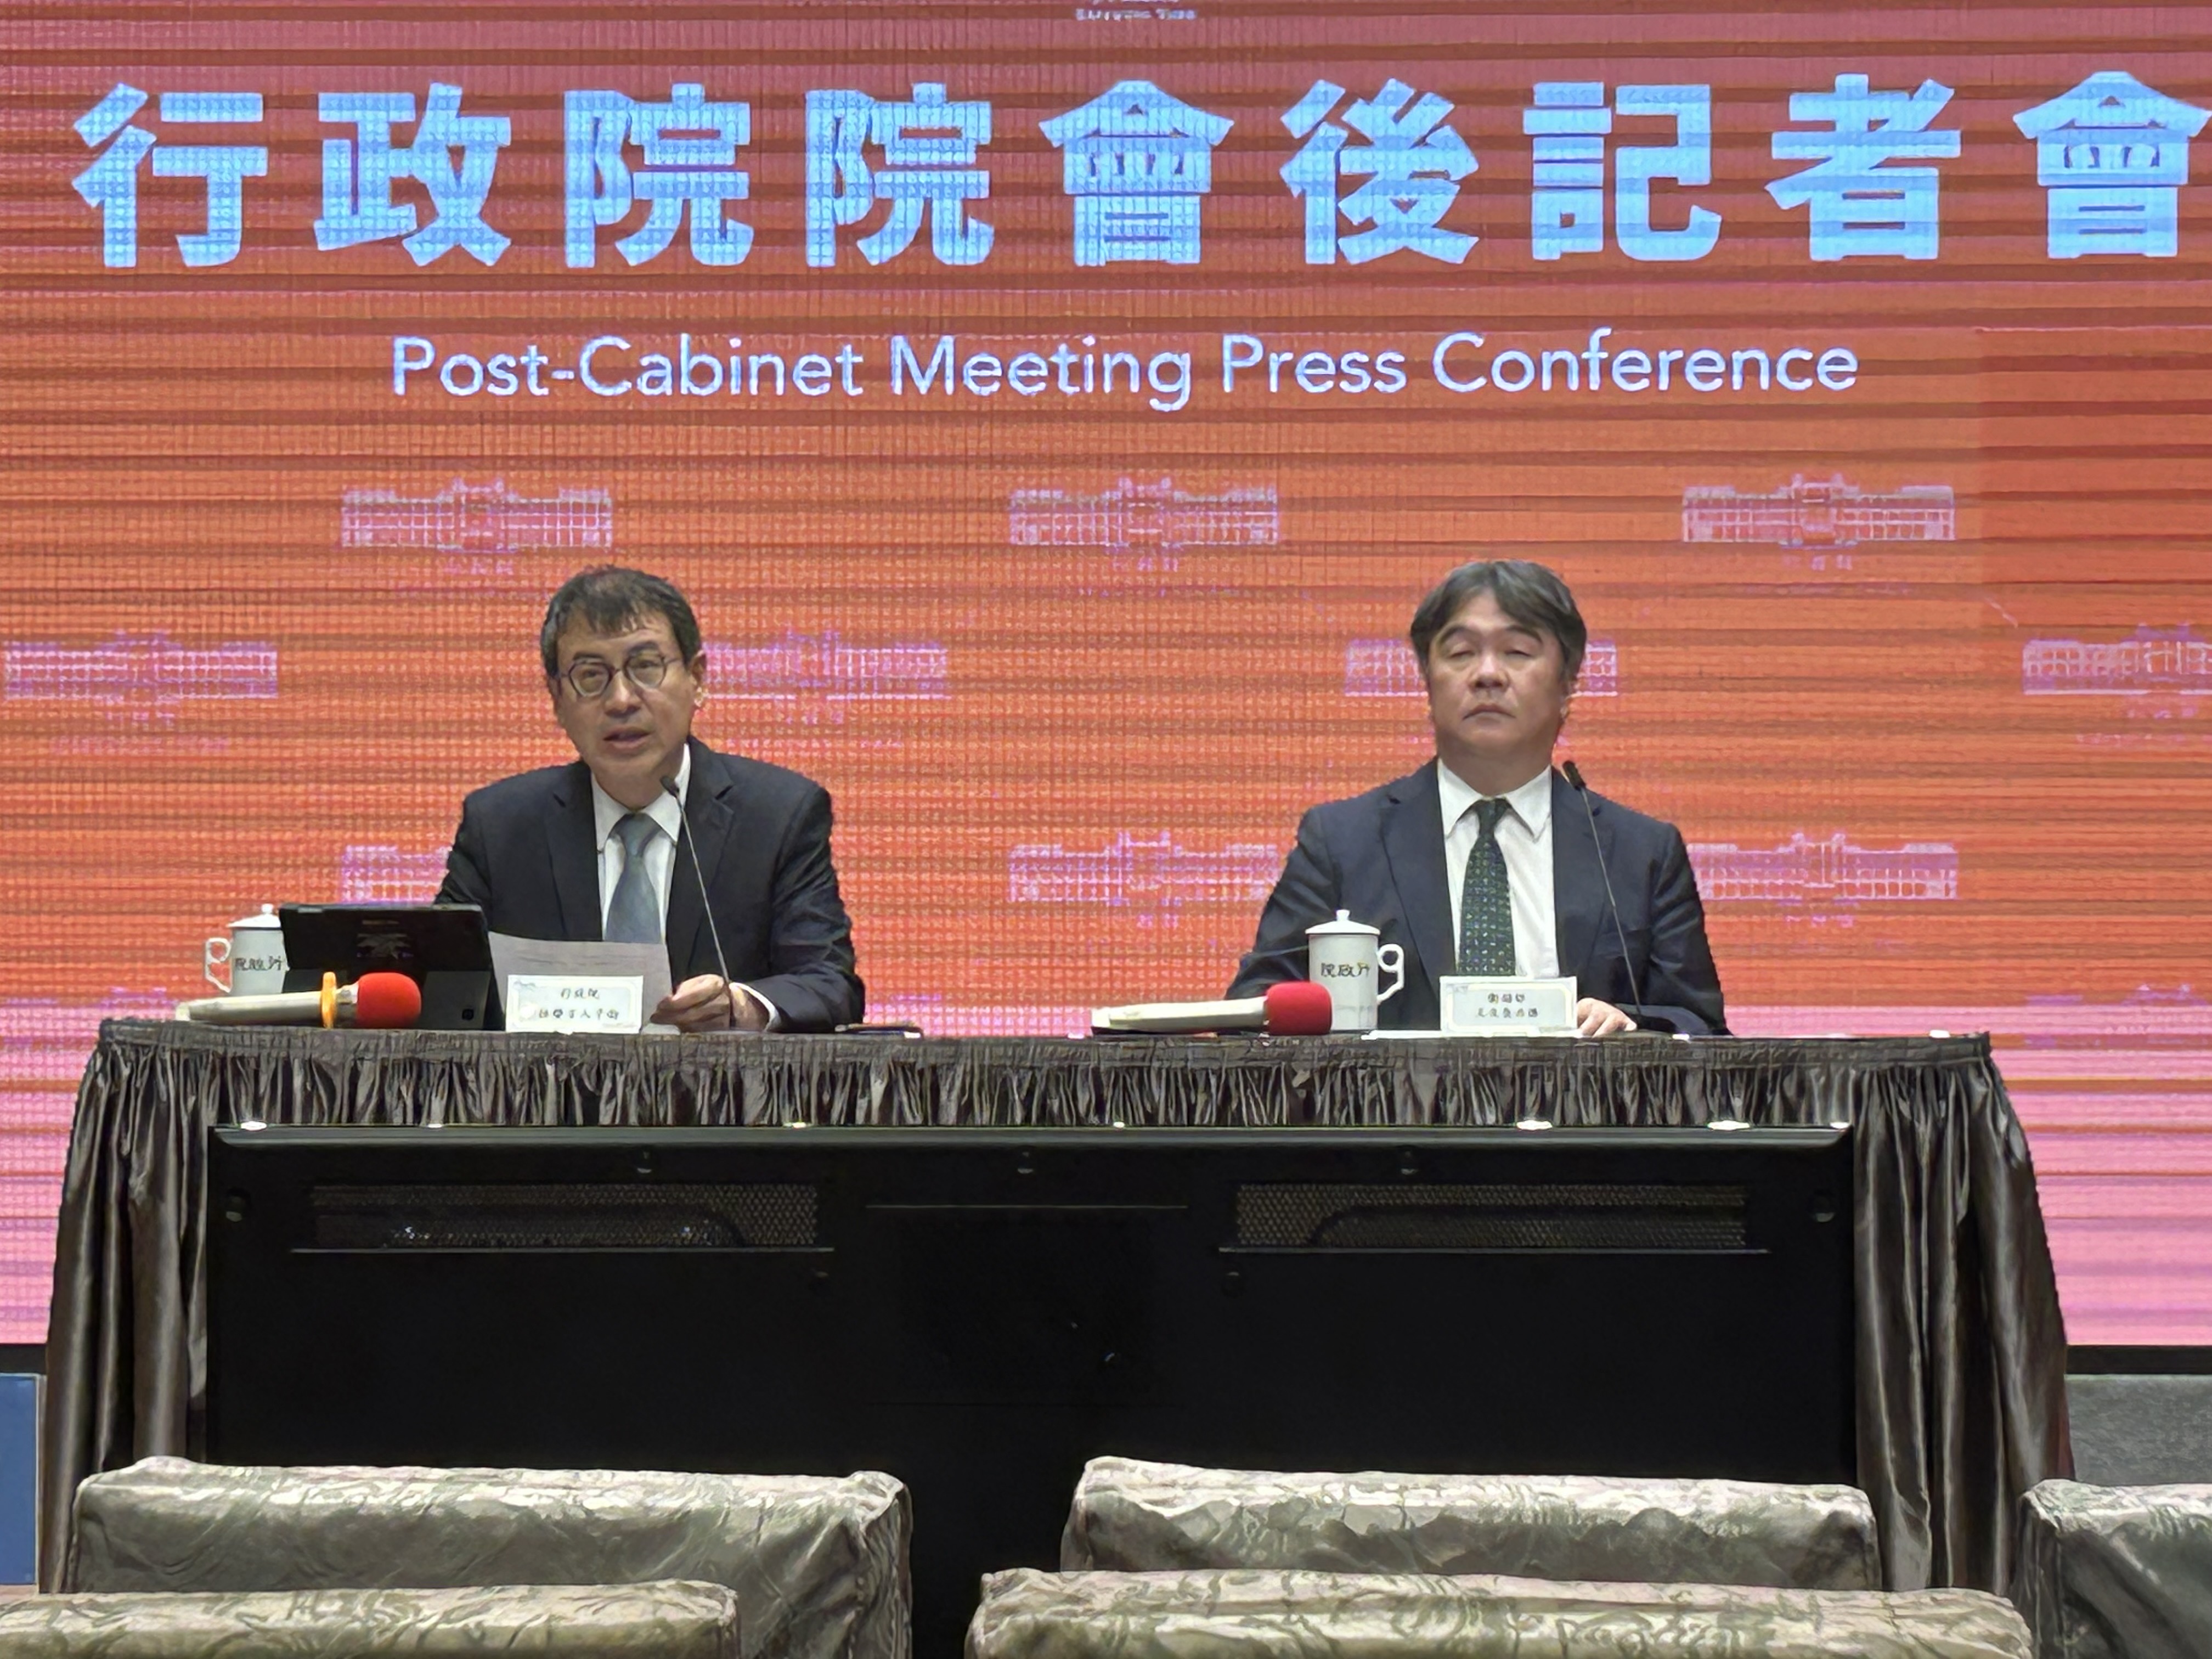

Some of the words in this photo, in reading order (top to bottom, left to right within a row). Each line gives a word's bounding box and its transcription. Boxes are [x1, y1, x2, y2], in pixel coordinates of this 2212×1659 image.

[72, 71, 2212, 269] 行政院院會後記者會
[393, 333, 864, 397] Post-Cabinet
[890, 334, 1191, 412] Meeting
[1222, 334, 1407, 393] Press
[1432, 328, 1858, 393] Conference
